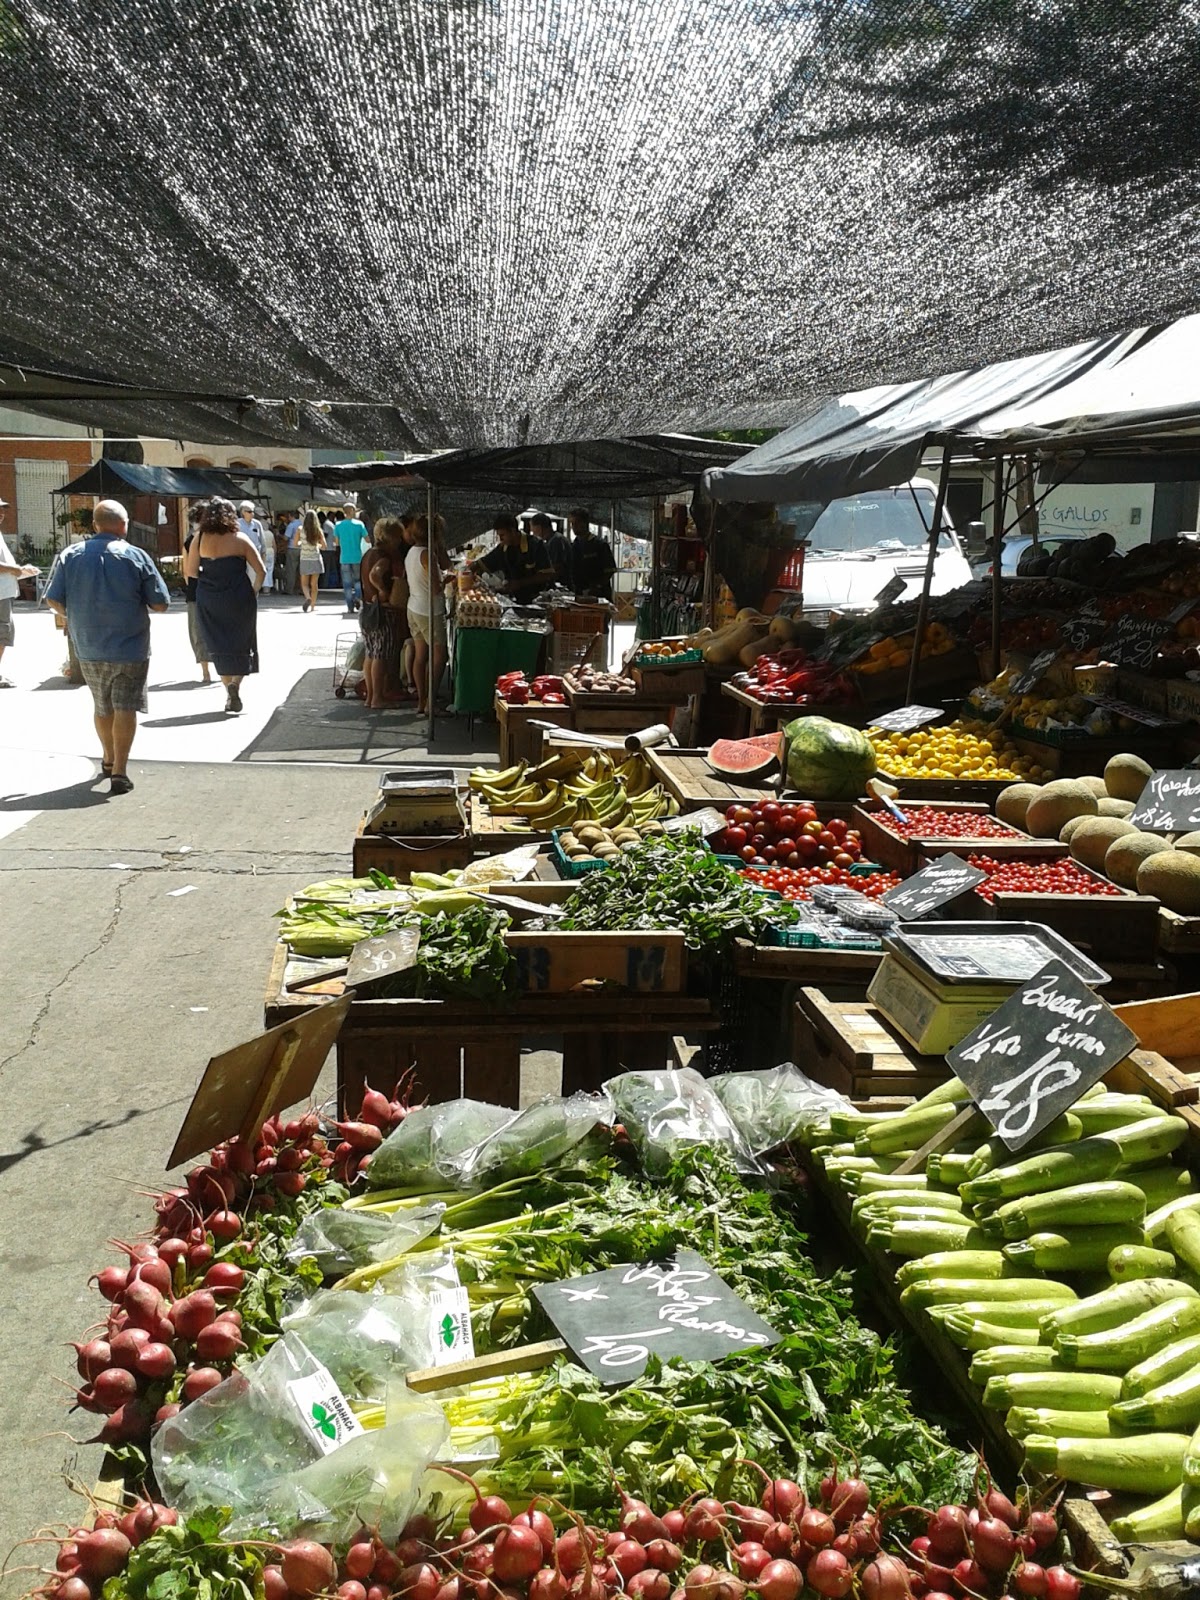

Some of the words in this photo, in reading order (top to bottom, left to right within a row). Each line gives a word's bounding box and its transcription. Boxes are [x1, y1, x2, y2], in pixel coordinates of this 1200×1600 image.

[1052, 506, 1109, 522] GALLOS
[979, 1046, 1082, 1138] 18
[460, 1312, 470, 1345] ALBAHACA
[328, 1395, 355, 1432] ALBAHACA
